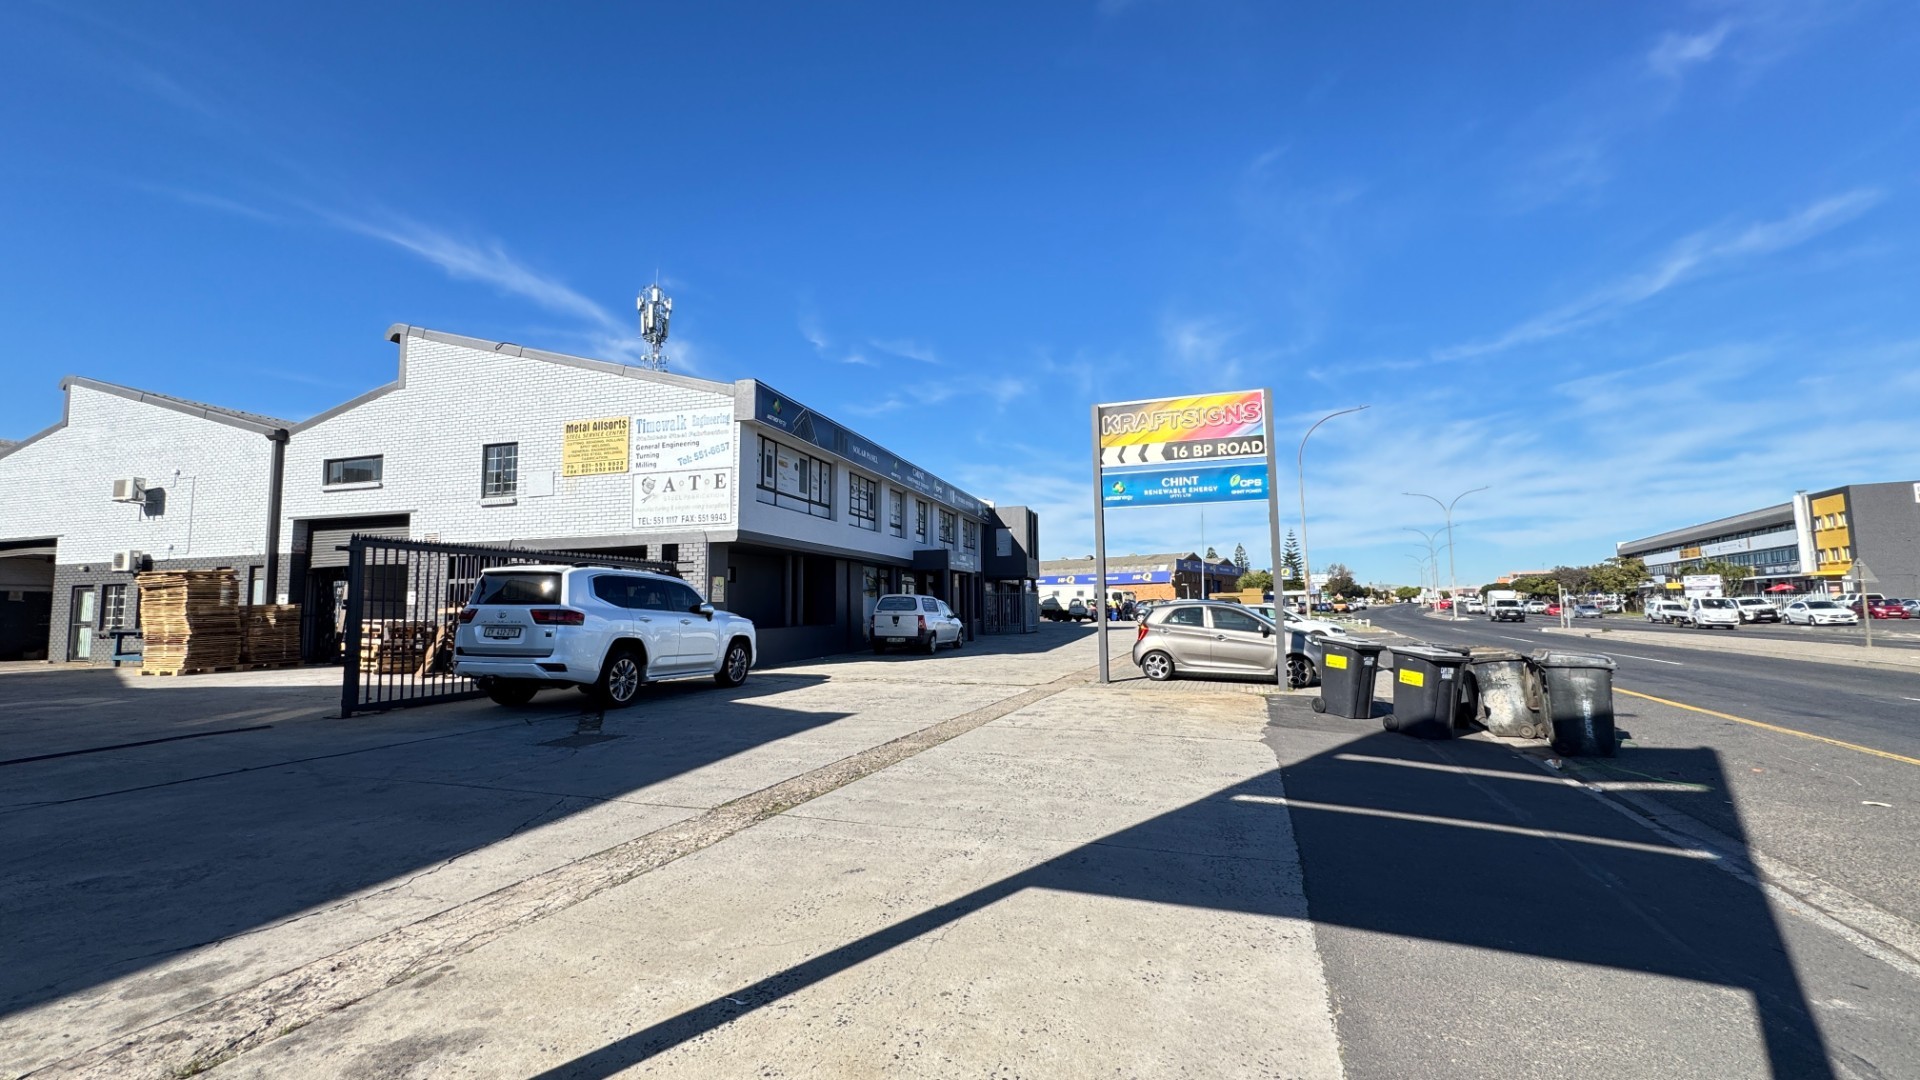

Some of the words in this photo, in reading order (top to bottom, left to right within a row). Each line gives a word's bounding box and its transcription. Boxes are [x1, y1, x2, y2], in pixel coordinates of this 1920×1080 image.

[635, 414, 687, 434] Timewalk
[692, 413, 731, 429] Engineering
[1101, 401, 1263, 436] KRAFTSIGNS
[566, 422, 590, 434] Metal
[592, 419, 627, 431] Allsorts
[582, 431, 604, 439] SERVICE
[605, 429, 627, 437] CENTRE
[635, 443, 660, 451] General
[661, 440, 700, 449] Engineering
[1171, 446, 1187, 459] 16
[1192, 443, 1213, 458] BP
[1217, 440, 1263, 455] ROAD
[635, 451, 660, 460] Turning
[677, 454, 693, 466] Tel:
[635, 461, 657, 469] Milling
[662, 476, 676, 493] A
[688, 474, 702, 491] T
[713, 472, 727, 490] E
[1161, 475, 1199, 487] CHINT
[1239, 478, 1263, 487] CPS
[1144, 487, 1187, 496] RENEWABLE
[1188, 485, 1218, 493] ENERGY
[638, 517, 652, 525] TEL:
[653, 516, 664, 525] 551
[681, 514, 697, 523] FAX:
[697, 513, 709, 522] 551
[710, 512, 727, 521] 9943
